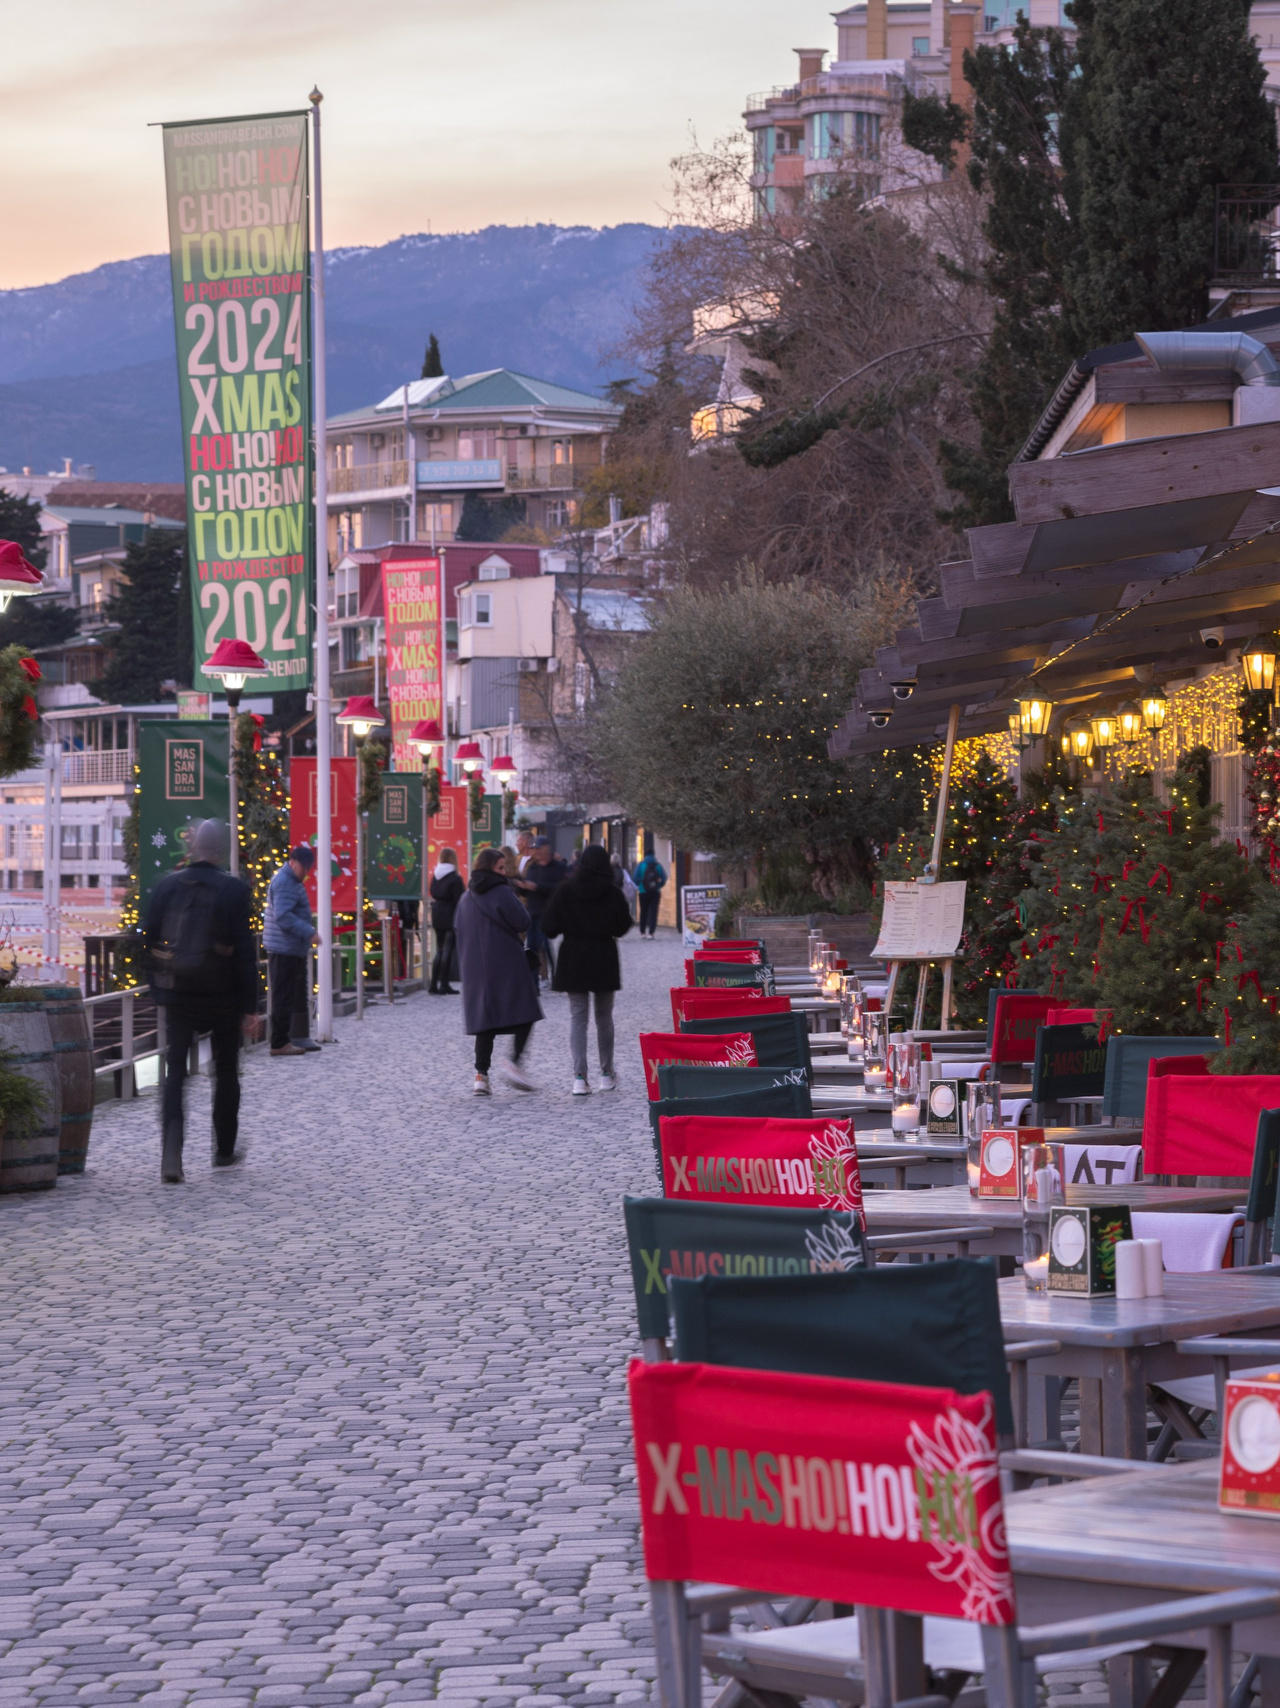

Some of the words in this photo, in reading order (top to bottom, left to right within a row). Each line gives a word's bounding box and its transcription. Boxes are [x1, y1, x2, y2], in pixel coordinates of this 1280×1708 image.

[173, 123, 299, 148] MASSANDRABEACH.COM
[201, 185, 301, 232] НОВЫМ
[181, 223, 304, 282] ГОДОМ
[183, 283, 196, 303] И
[185, 294, 302, 376] 2024
[189, 369, 301, 434] XMAS
[192, 474, 211, 512] С
[198, 562, 209, 581] И
[389, 601, 438, 625] ГОДОМ
[391, 644, 438, 671] XMAS
[173, 748, 196, 760] MAS
[174, 760, 195, 773] SAN
[174, 773, 195, 785] DRA
